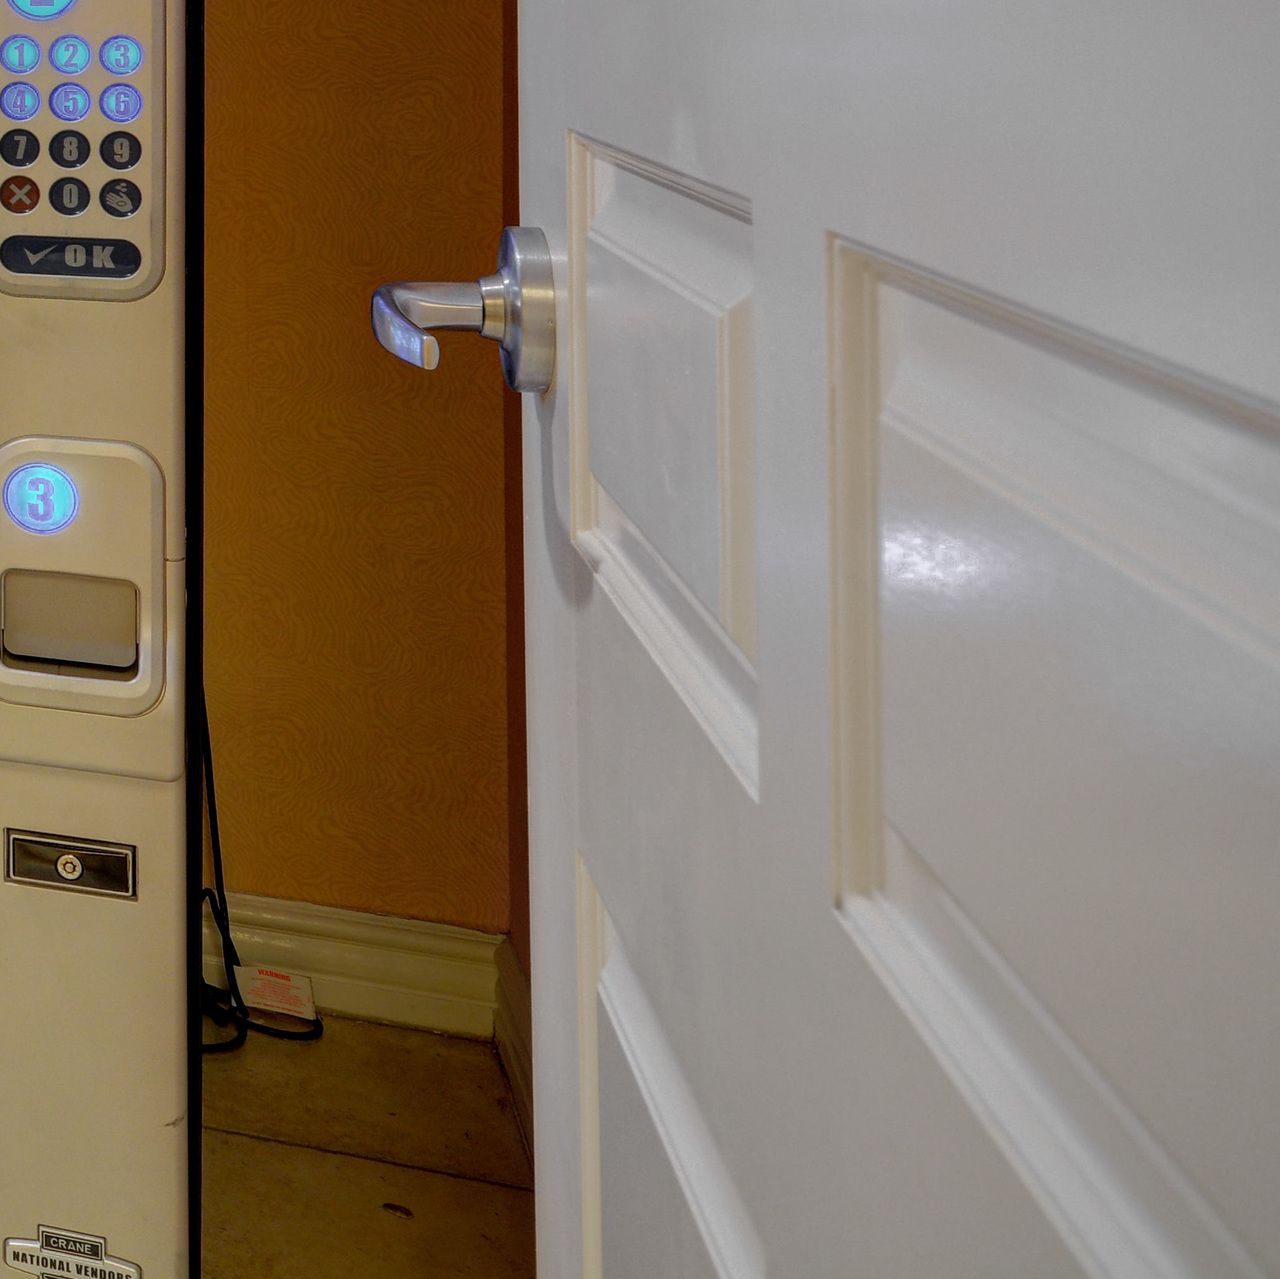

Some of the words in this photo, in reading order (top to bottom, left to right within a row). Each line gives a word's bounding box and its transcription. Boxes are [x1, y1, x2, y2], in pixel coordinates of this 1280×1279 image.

[14, 42, 26, 68] 1
[63, 43, 80, 68] 2
[114, 43, 130, 69] 3
[12, 89, 28, 113] 4
[62, 90, 80, 116] 5
[114, 91, 131, 117] 6
[13, 135, 28, 160] 7
[62, 136, 79, 162] 8
[113, 137, 131, 163] 9
[63, 183, 79, 208] 0
[64, 244, 116, 269] OK
[27, 476, 55, 522] 3
[257, 968, 292, 982] WARNING
[50, 1237, 93, 1255] CRANE
[12, 1250, 72, 1273] NATIONAL
